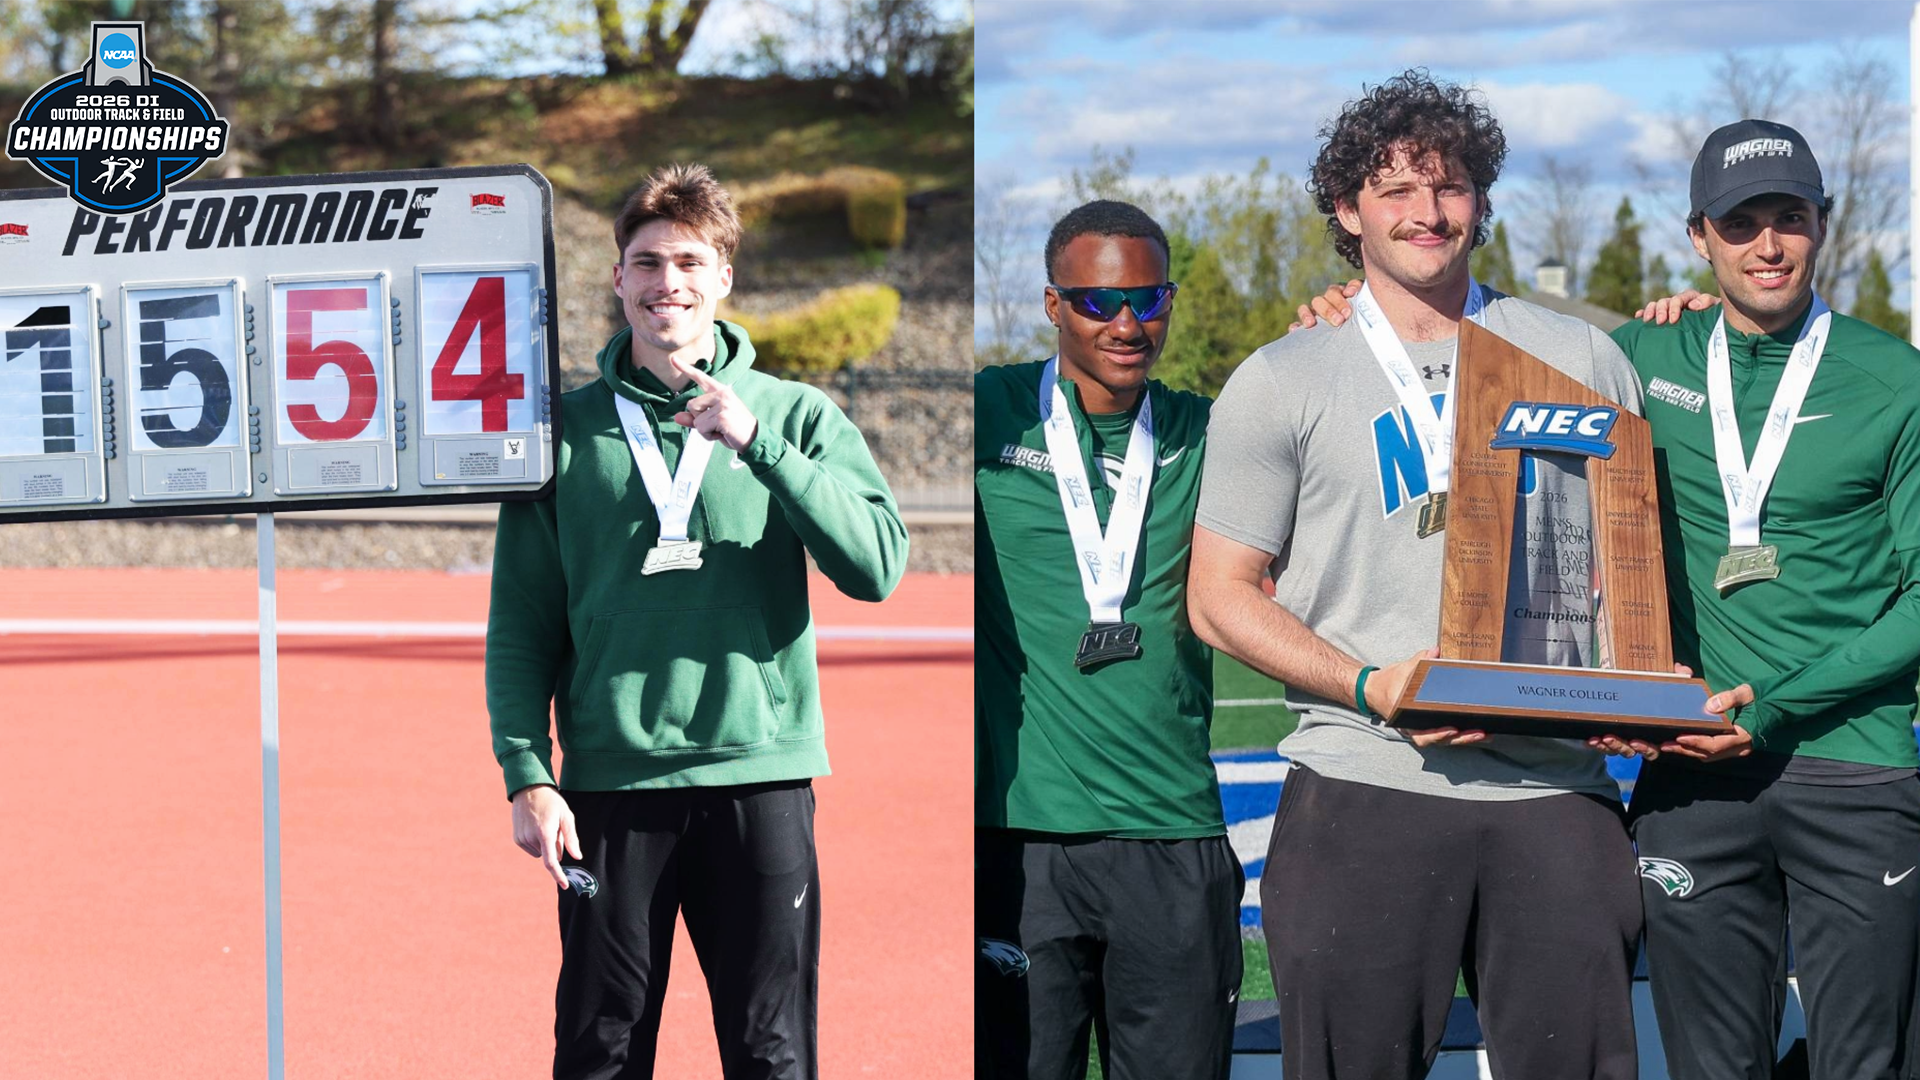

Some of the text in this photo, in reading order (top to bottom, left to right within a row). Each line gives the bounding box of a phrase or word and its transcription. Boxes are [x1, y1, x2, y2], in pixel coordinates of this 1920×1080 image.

[1724, 138, 1794, 162] WAGNER
[472, 193, 506, 207] BLAZER
[61, 187, 439, 256] PERFORMANCE
[5, 277, 525, 454] 1 5 5 4
[1646, 389, 1665, 401] TRACK
[1679, 401, 1701, 414] FIELD
[1649, 376, 1707, 407] WAGNER
[1505, 407, 1611, 436] NEC
[1001, 443, 1052, 466] WAGN
[1066, 477, 1090, 506] NEC
[1540, 492, 1568, 503] 2026
[1523, 532, 1586, 545] OUTDOOR
[648, 546, 698, 567] NEC
[1522, 547, 1589, 561] TRACK AND
[1719, 550, 1774, 578] NEC
[1539, 564, 1571, 576] FIELD
[1513, 606, 1597, 624] Champions
[1081, 626, 1138, 655] NEC
[1517, 685, 1620, 701] WAGNER COLLEGE
